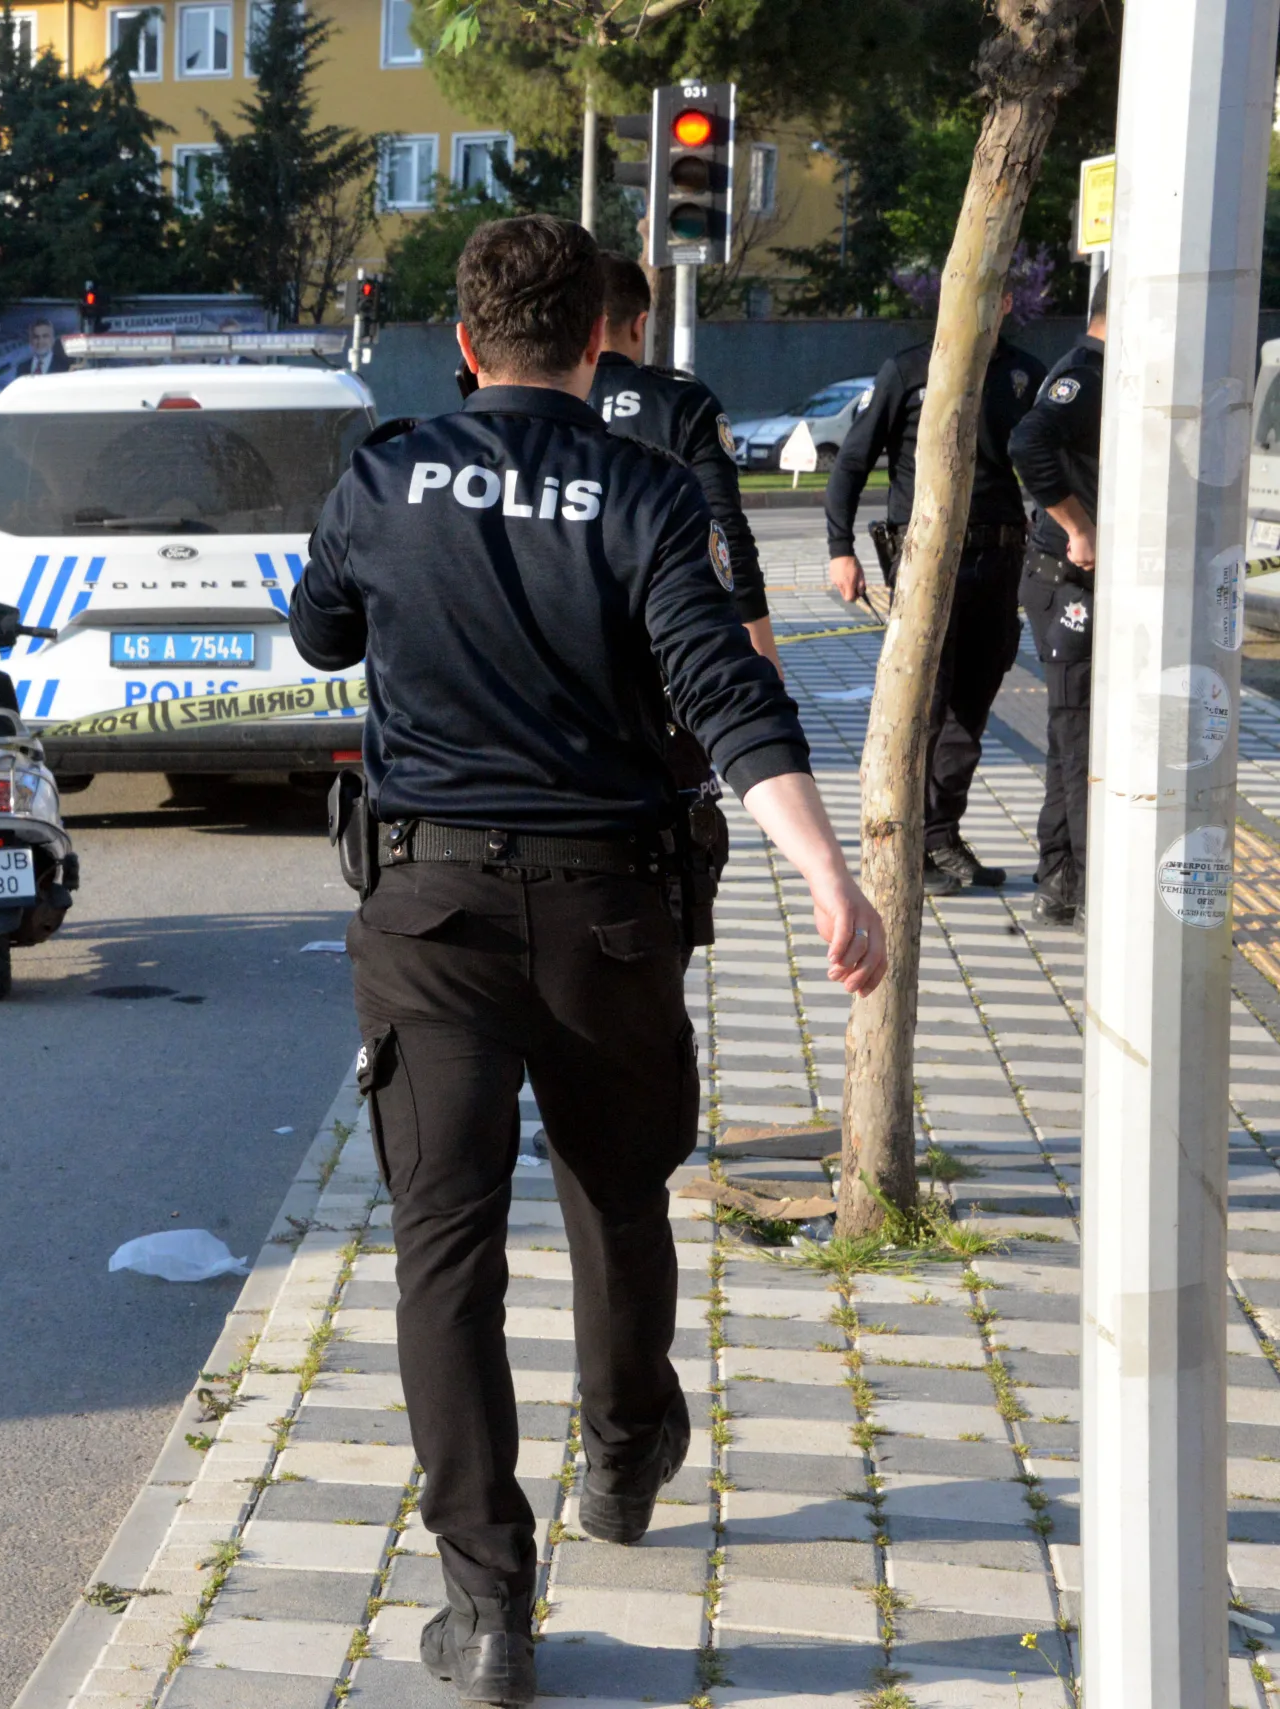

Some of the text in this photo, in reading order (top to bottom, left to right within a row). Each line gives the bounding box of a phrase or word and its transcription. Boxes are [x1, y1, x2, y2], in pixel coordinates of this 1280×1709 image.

[683, 86, 708, 98] 031
[84, 579, 278, 590] TOURNEO
[123, 635, 243, 660] 46 A 7544
